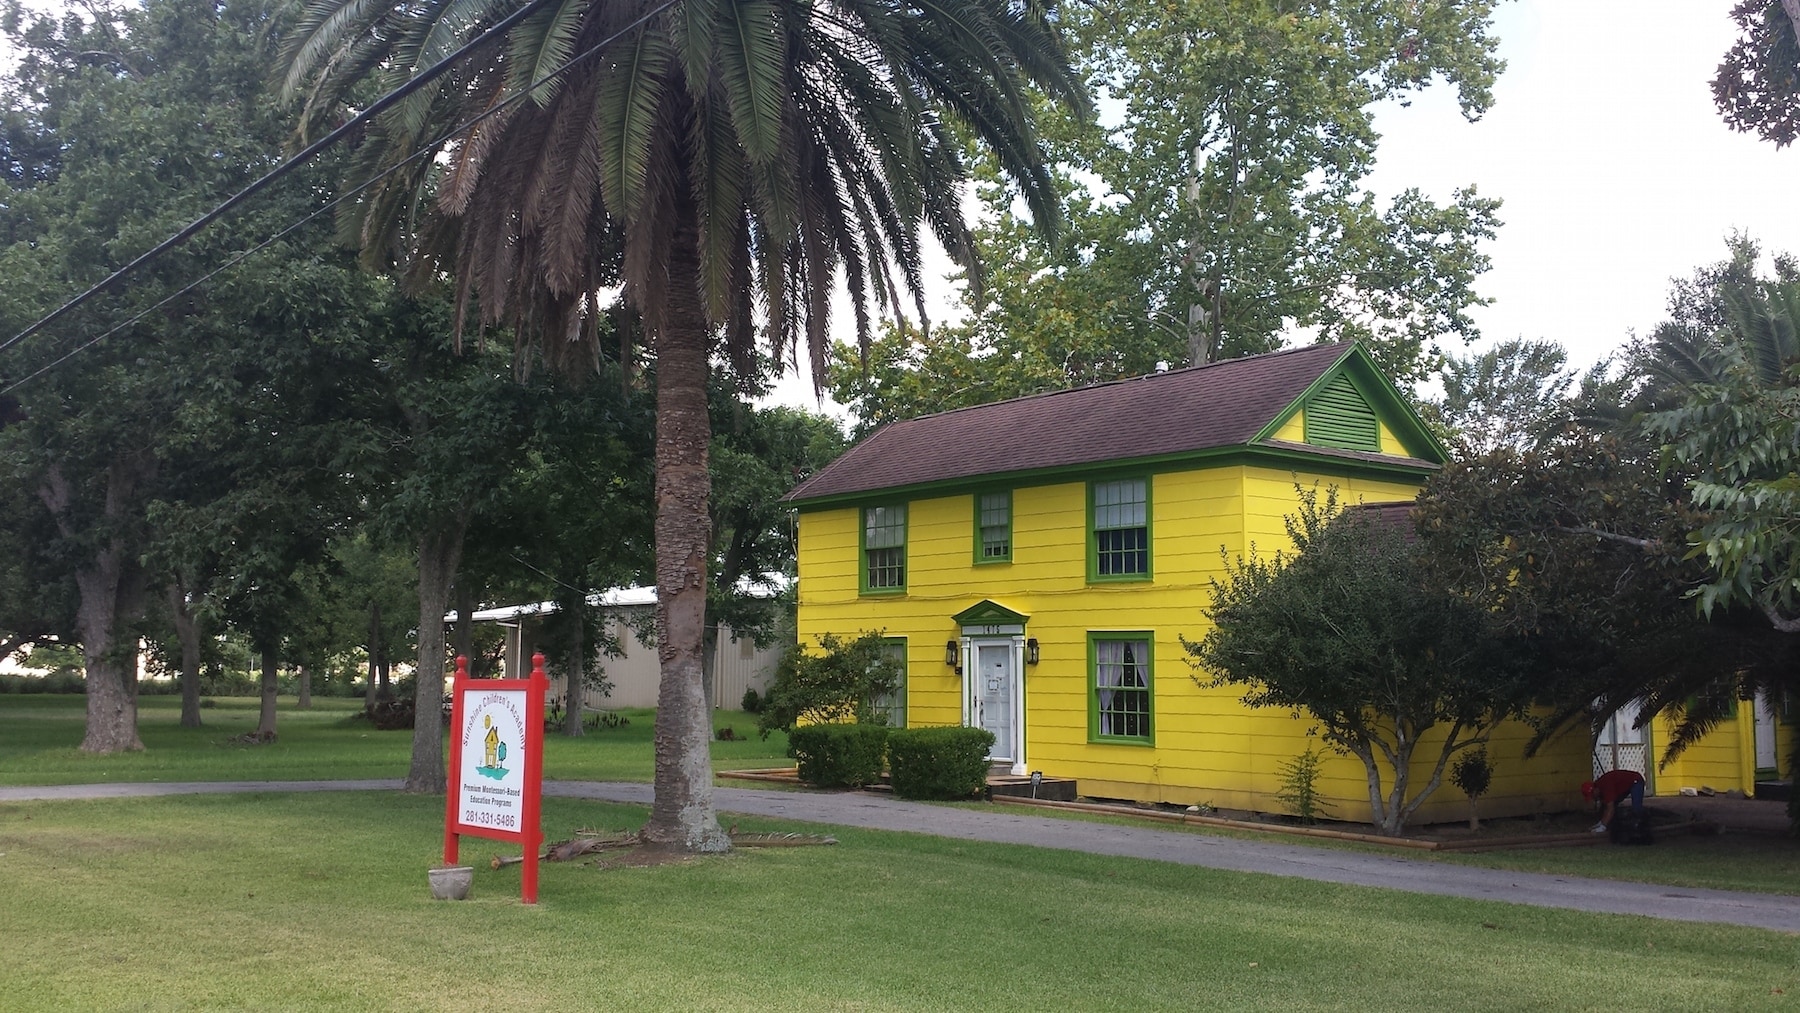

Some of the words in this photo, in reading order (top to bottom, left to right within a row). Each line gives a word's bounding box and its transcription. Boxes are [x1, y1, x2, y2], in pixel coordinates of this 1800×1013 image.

[463, 703, 483, 747] Sunshine
[482, 692, 510, 709] Children's
[510, 703, 526, 750] Academy
[463, 783, 482, 793] Premium
[482, 786, 520, 797] Montessori-Based
[470, 795, 491, 805] Education
[491, 797, 512, 808] Programs
[465, 810, 515, 827] 281-331-5486
